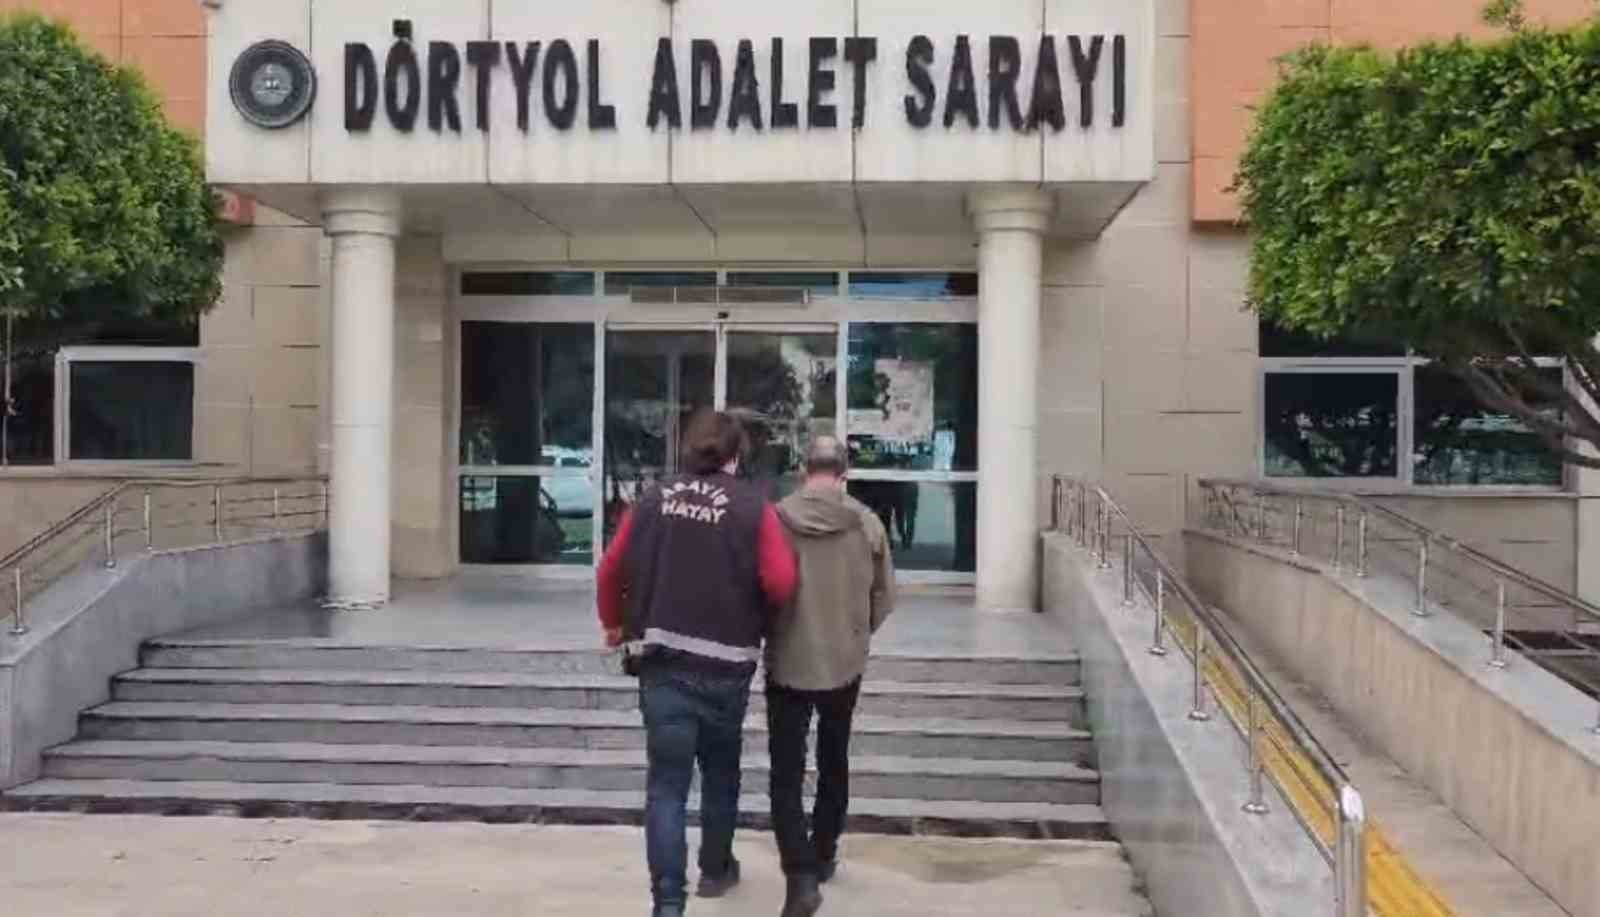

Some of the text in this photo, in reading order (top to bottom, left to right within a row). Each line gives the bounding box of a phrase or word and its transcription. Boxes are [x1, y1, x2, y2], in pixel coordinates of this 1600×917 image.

[344, 19, 1127, 134] DÖRTYOL ADALET SARAYI
